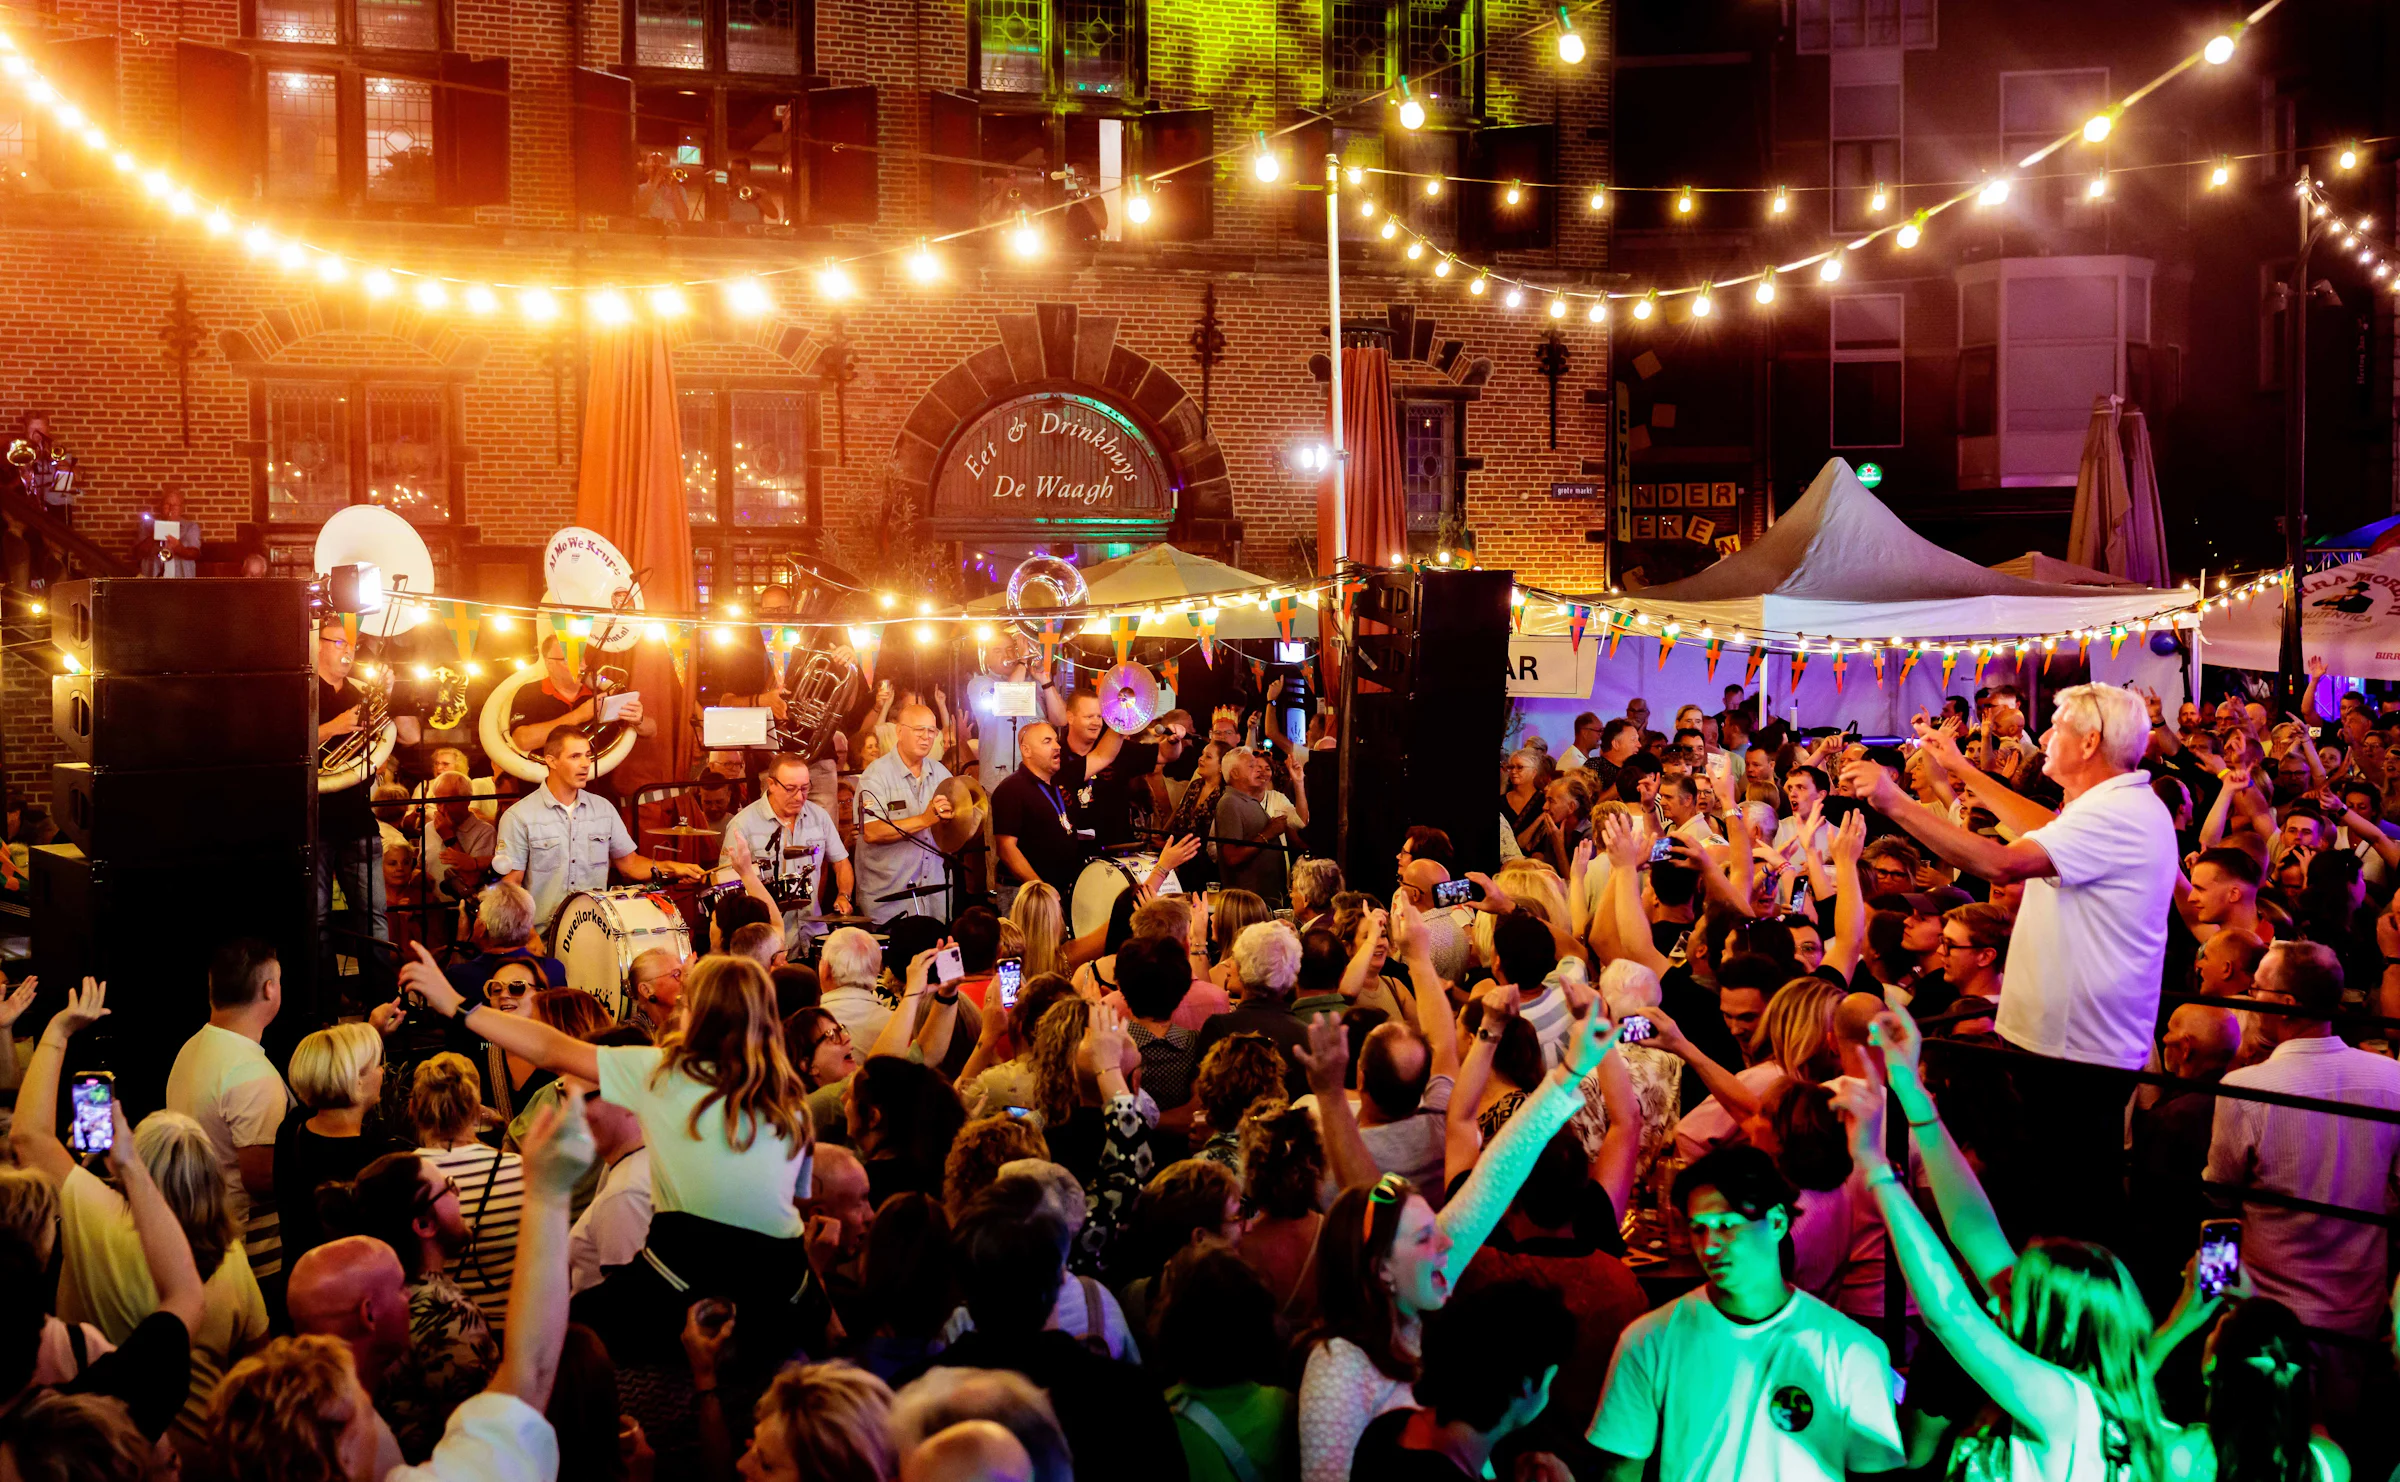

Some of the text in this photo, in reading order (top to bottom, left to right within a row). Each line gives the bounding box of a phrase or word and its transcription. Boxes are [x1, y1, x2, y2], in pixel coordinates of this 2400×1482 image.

[964, 412, 1138, 482] Eet & Drinkhuys
[1620, 409, 1628, 530] EXIT
[993, 475, 1114, 505] De Waagh
[1557, 487, 1593, 496] grote markt
[1636, 485, 1732, 505] NDER
[1637, 516, 1738, 556] EKEN
[1505, 655, 1539, 681] AR
[2375, 651, 2400, 660] BIRR
[562, 908, 611, 953] Dweilorkest
